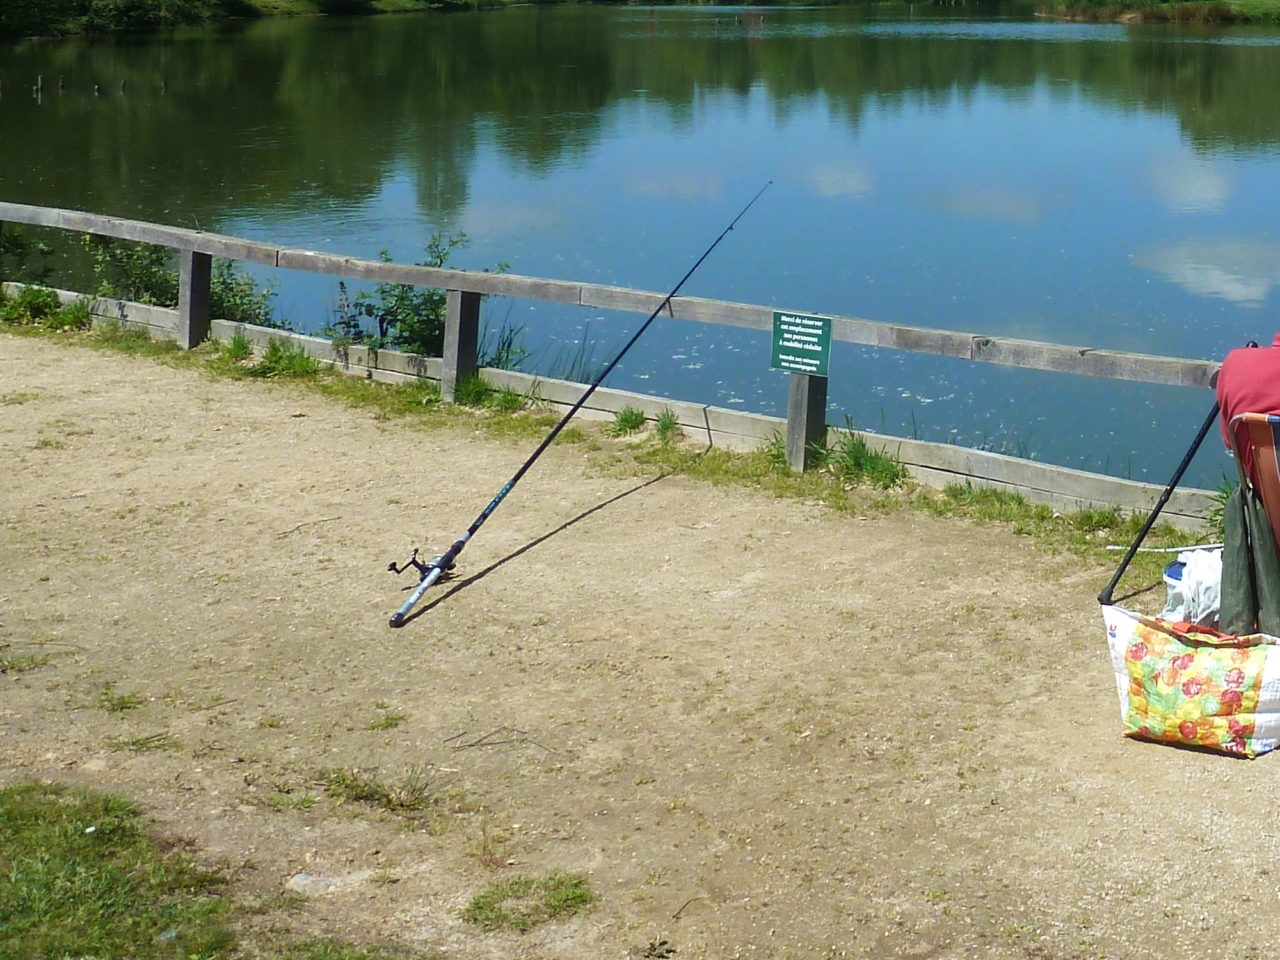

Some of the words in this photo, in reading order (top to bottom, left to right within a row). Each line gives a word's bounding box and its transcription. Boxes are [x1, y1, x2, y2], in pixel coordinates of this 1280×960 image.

[788, 325, 822, 334] emplacement
[792, 334, 817, 342] personnes
[782, 340, 802, 348] mobilité
